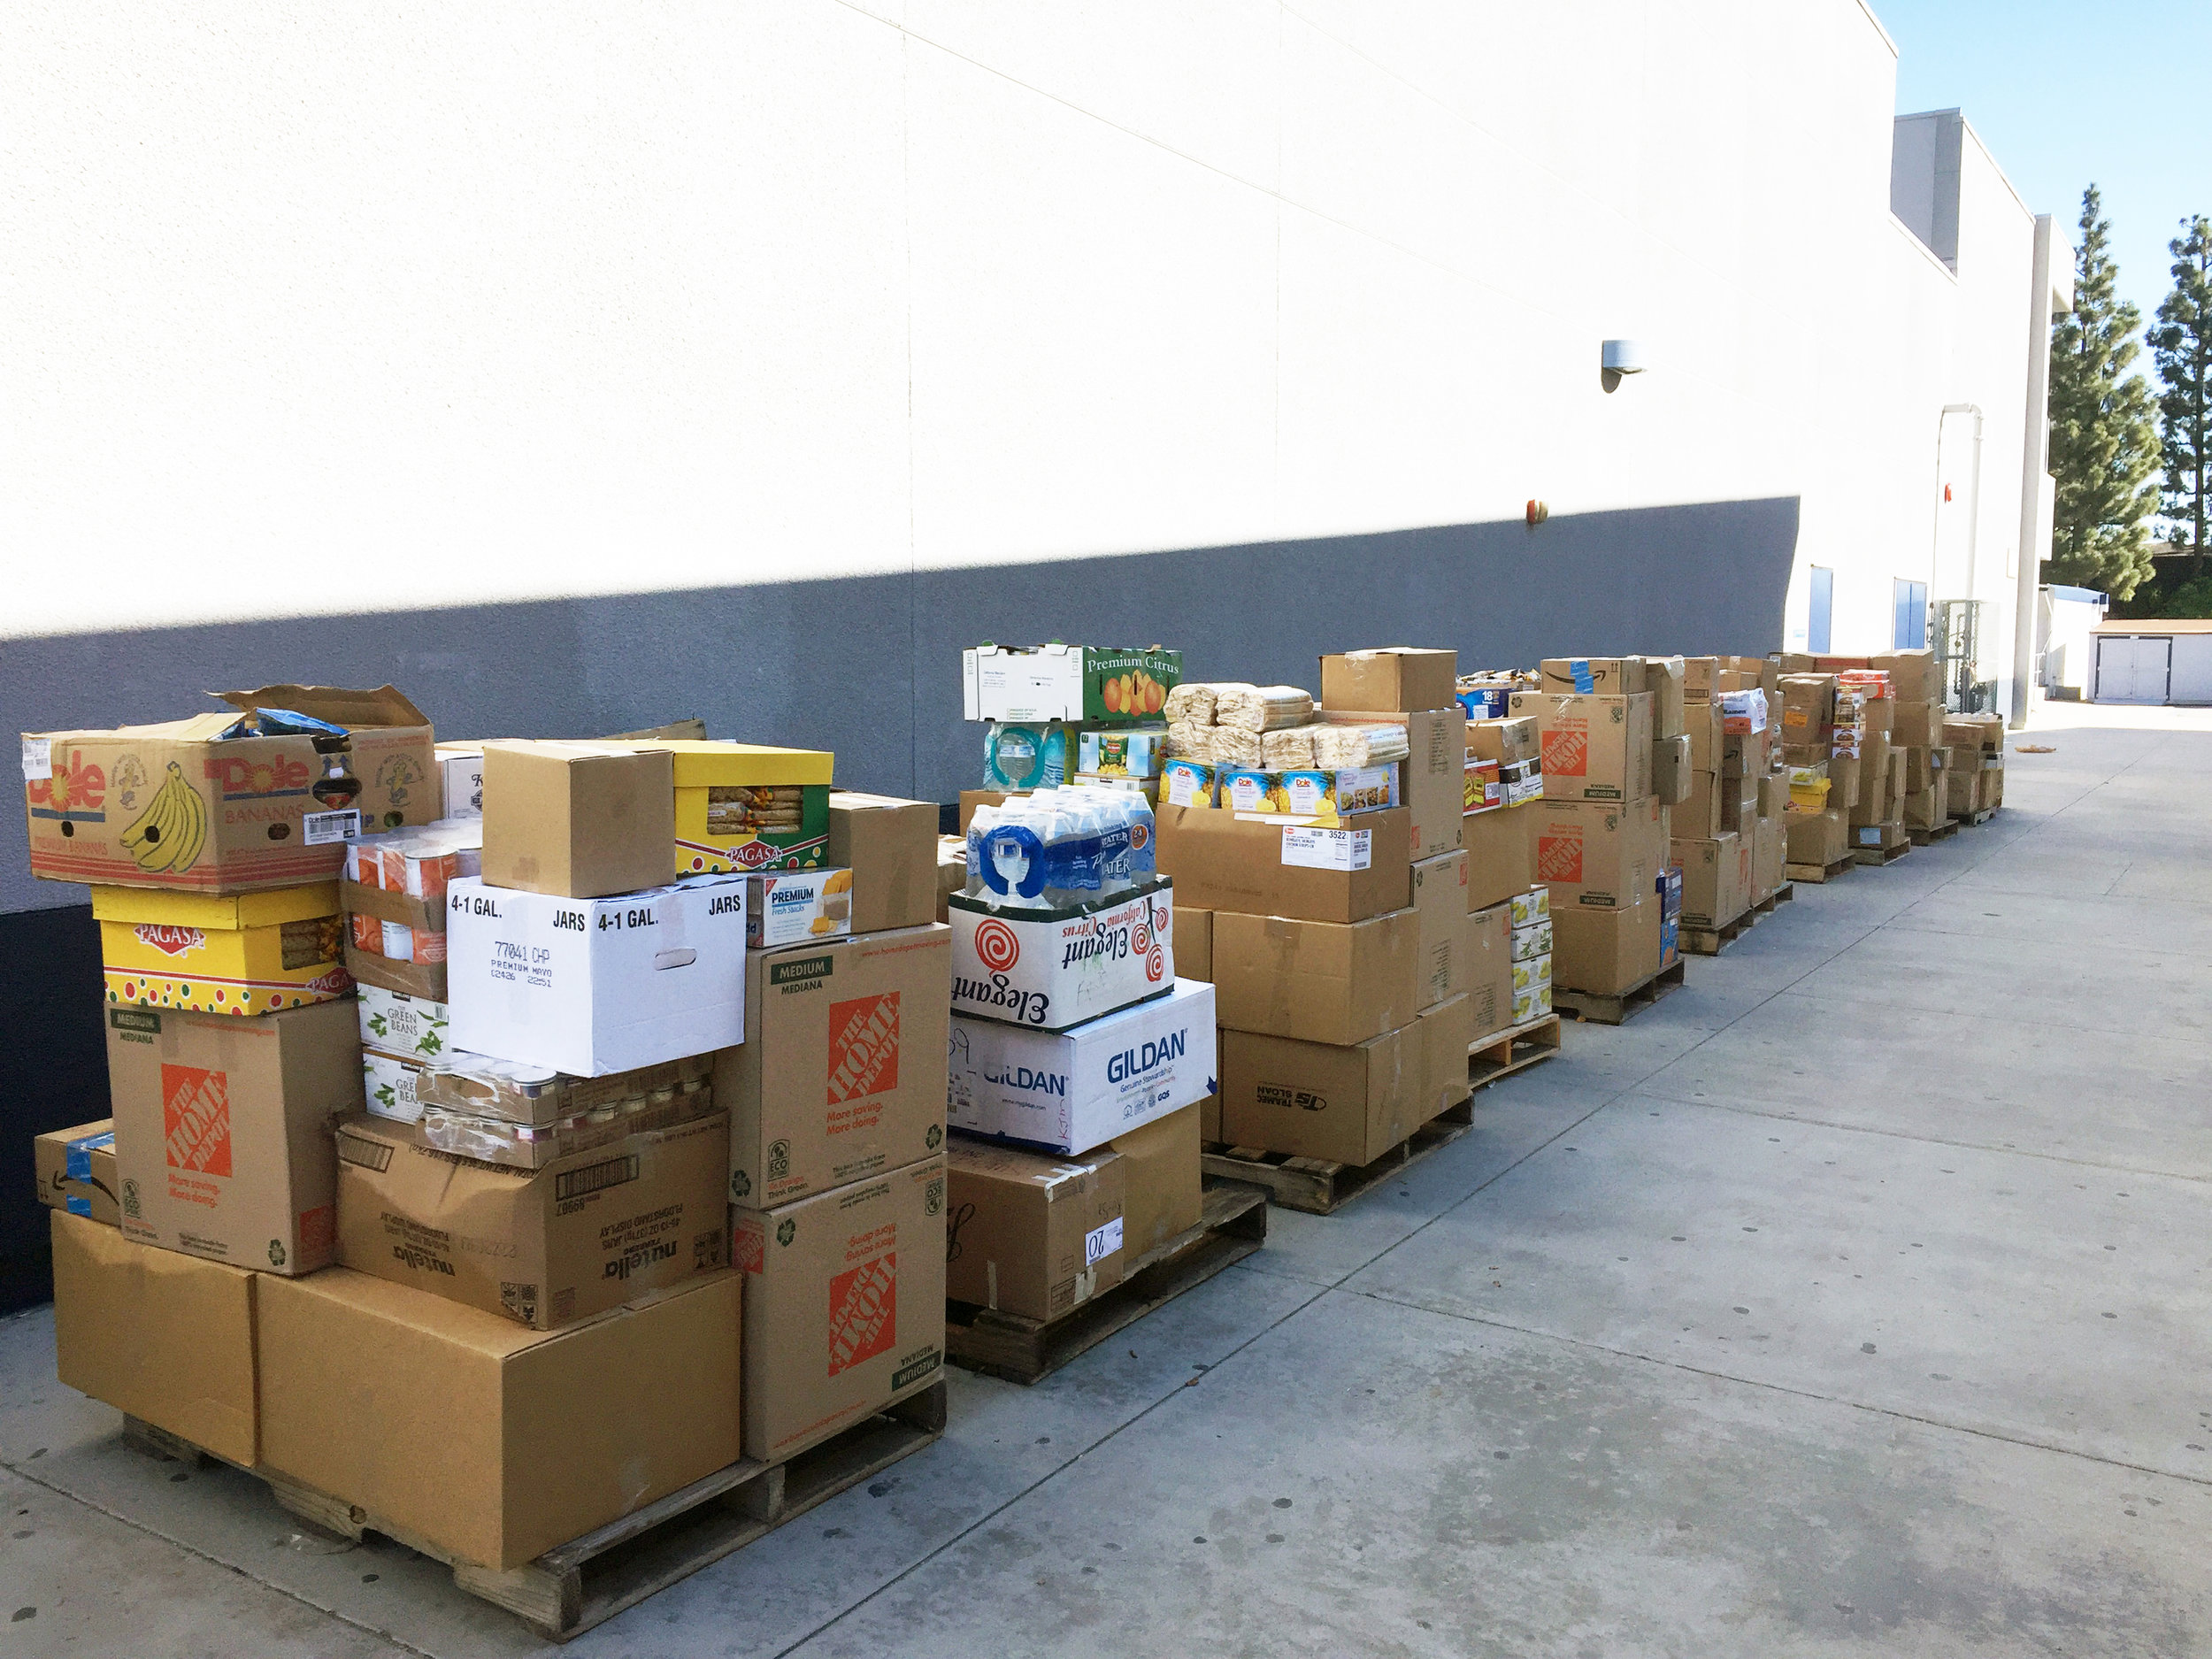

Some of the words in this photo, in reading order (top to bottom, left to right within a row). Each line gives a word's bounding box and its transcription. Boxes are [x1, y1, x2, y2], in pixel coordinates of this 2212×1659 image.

[1087, 655, 1142, 673] Premium
[1145, 656, 1179, 675] Citrus
[1482, 691, 1494, 702] 18
[1541, 731, 1587, 775] HOME
[221, 754, 310, 794] Dole
[226, 803, 304, 824] BANANAS
[1328, 830, 1347, 840] 3522
[729, 846, 782, 862] PAGASA
[772, 887, 814, 903] PREMIUM
[451, 895, 470, 913] 4-1
[474, 898, 503, 918] GAL.
[553, 910, 586, 932] JARS
[598, 912, 622, 932] 4-1
[627, 908, 659, 928] GAL.
[709, 894, 741, 917] JARS
[772, 905, 787, 916] Fresh
[1107, 901, 1146, 931] California
[140, 924, 204, 946] PAGASA
[1062, 916, 1097, 940] Citrus
[532, 947, 550, 964] CHP
[1061, 922, 1128, 970] Elegant
[491, 960, 529, 973] PREMIUM
[532, 966, 553, 978] MAYO
[780, 961, 826, 979] MEDIUM
[310, 974, 349, 993] PAGA
[781, 979, 823, 995] MEDIANA
[951, 975, 1050, 1025] Elegant
[117, 1012, 156, 1029] MEDIUM
[388, 1008, 417, 1024] GREEN
[391, 1021, 419, 1036] BEANS
[835, 1008, 867, 1052] THE
[827, 992, 901, 1102] HOME
[1107, 1028, 1186, 1084] GILDAN
[856, 1026, 900, 1097] DEPOT
[396, 1079, 418, 1093] GRE
[1256, 1086, 1293, 1098] SLOAN
[399, 1091, 419, 1104] BEA
[1256, 1094, 1292, 1108] TRAMEC
[165, 1070, 227, 1169] HOME
[826, 1108, 850, 1124] More
[853, 1101, 883, 1117] saving.
[826, 1122, 850, 1136] More
[852, 1113, 880, 1130] doing.
[770, 1160, 787, 1173] ECO
[926, 1186, 941, 1198] ECO
[1088, 1229, 1105, 1258] 20
[391, 1245, 456, 1277] nutella
[604, 1240, 678, 1281] nutella
[901, 1344, 934, 1367] MEDIANA
[897, 1358, 935, 1388] MEDIUM
